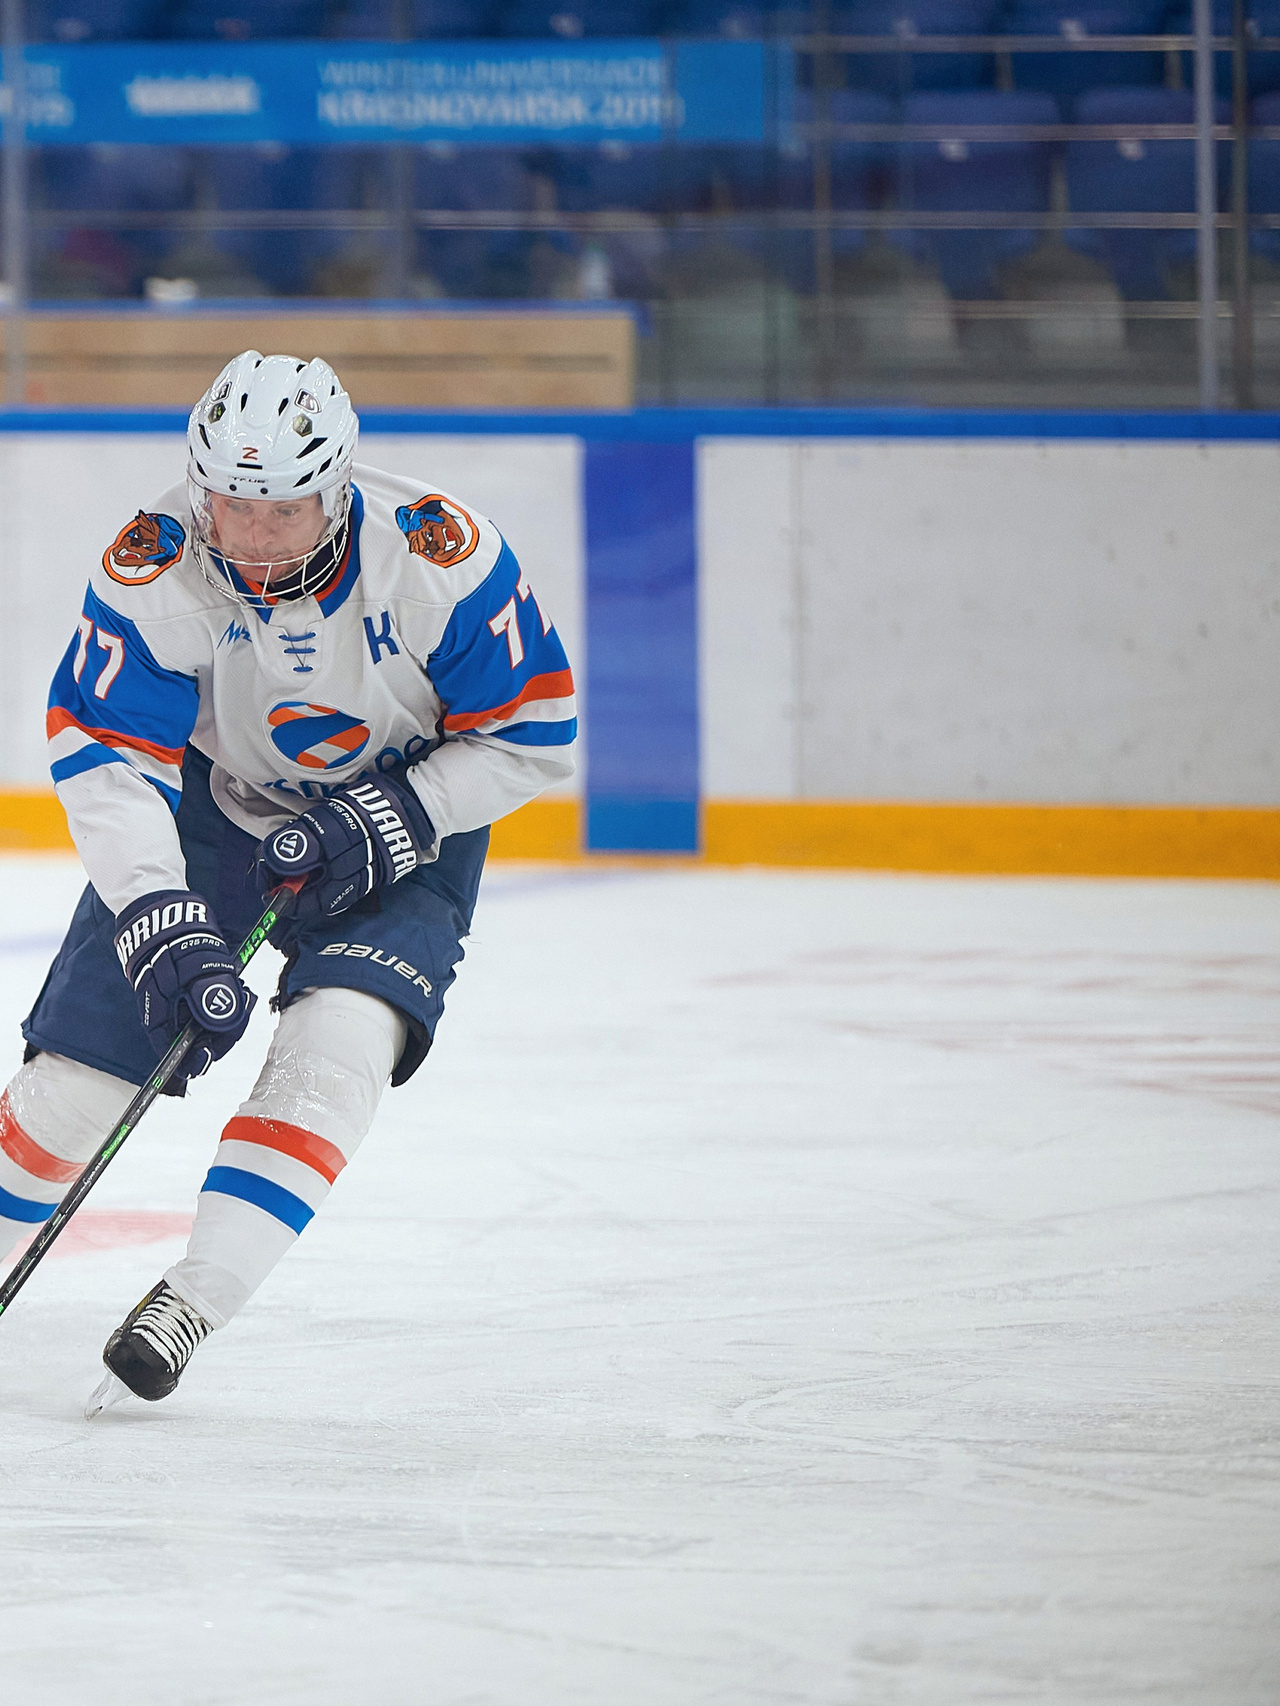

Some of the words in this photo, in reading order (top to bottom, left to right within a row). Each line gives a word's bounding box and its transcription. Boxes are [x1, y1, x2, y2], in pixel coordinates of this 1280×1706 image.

[341, 812, 359, 831] PRO
[116, 901, 208, 978] RRIOR
[201, 937, 220, 948] PRO
[239, 910, 278, 965] CCM
